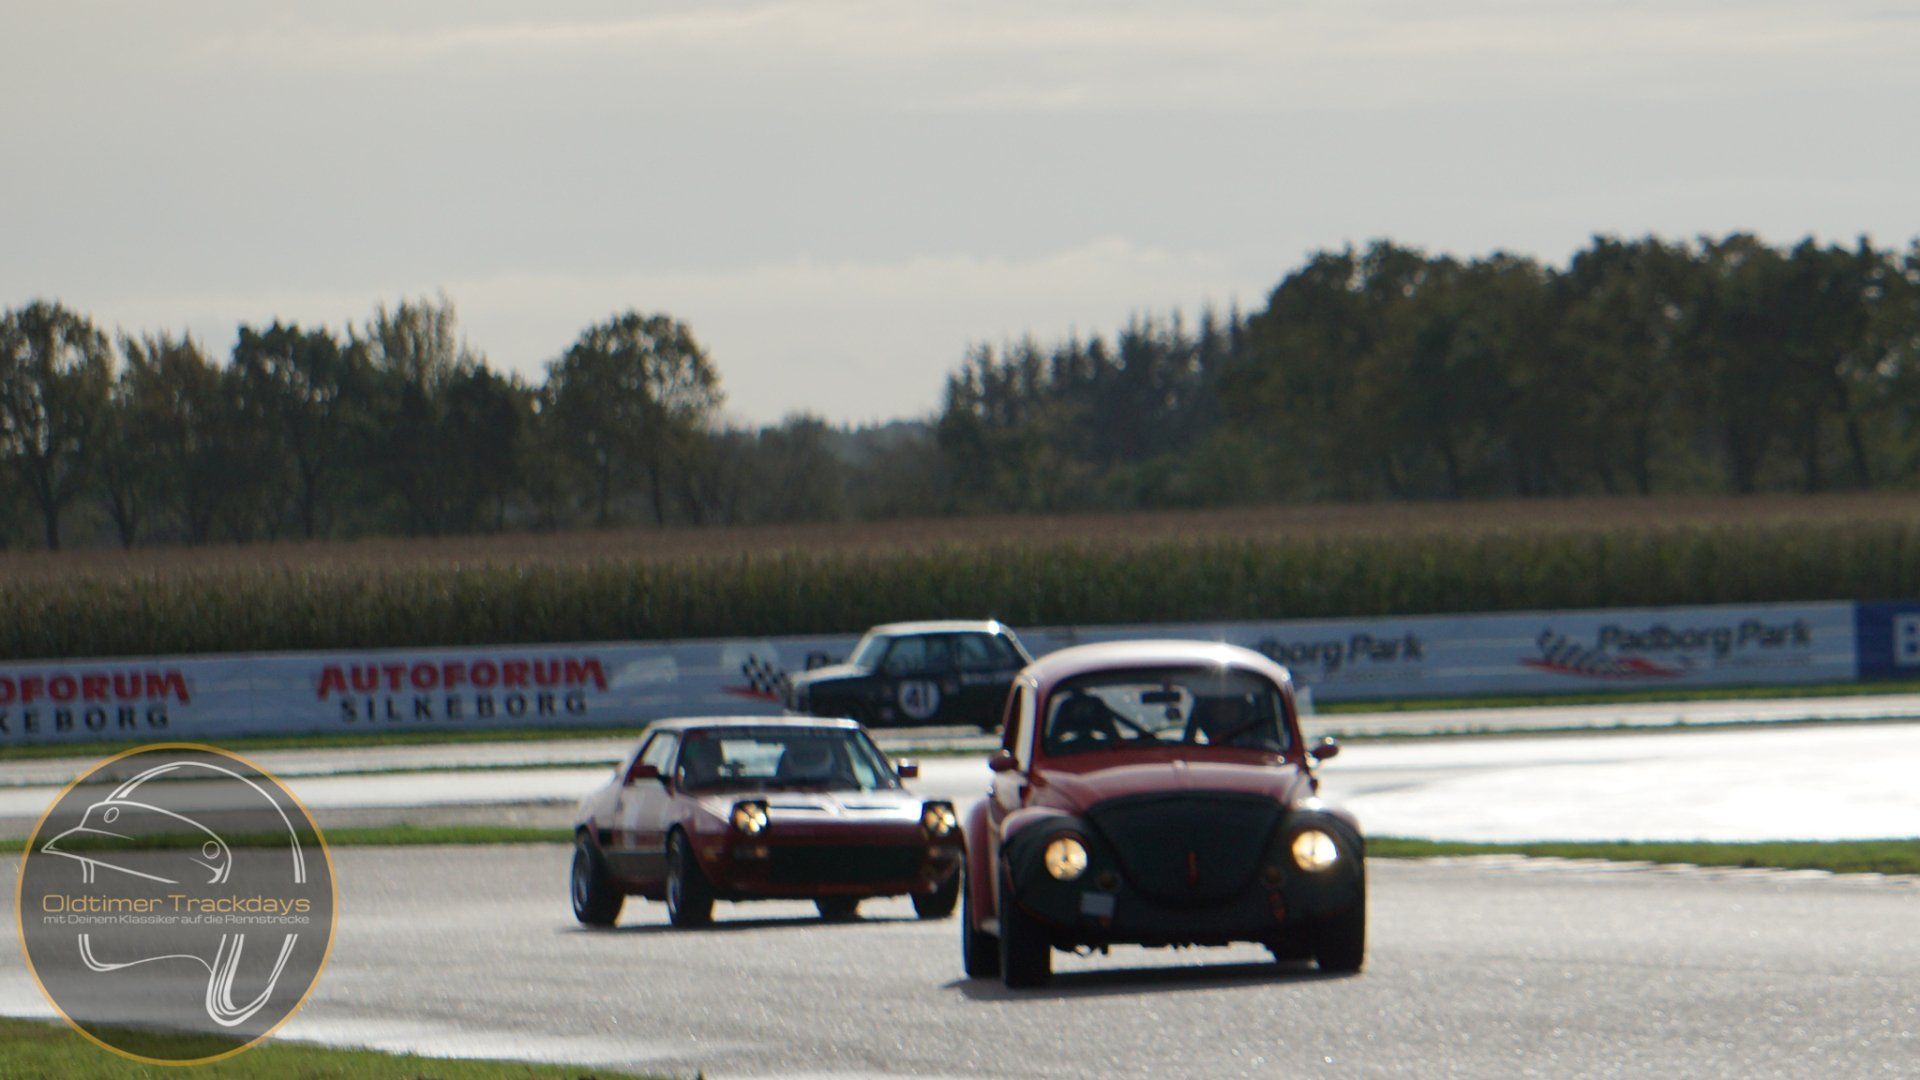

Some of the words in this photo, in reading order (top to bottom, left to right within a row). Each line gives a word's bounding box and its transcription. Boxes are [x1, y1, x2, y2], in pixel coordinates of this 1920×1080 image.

[1348, 631, 1425, 662] Park
[1598, 621, 1733, 660] Padborg
[1736, 617, 1812, 649] Park
[316, 656, 609, 701] AUTOFORUM
[340, 689, 588, 722] SILKEBORG
